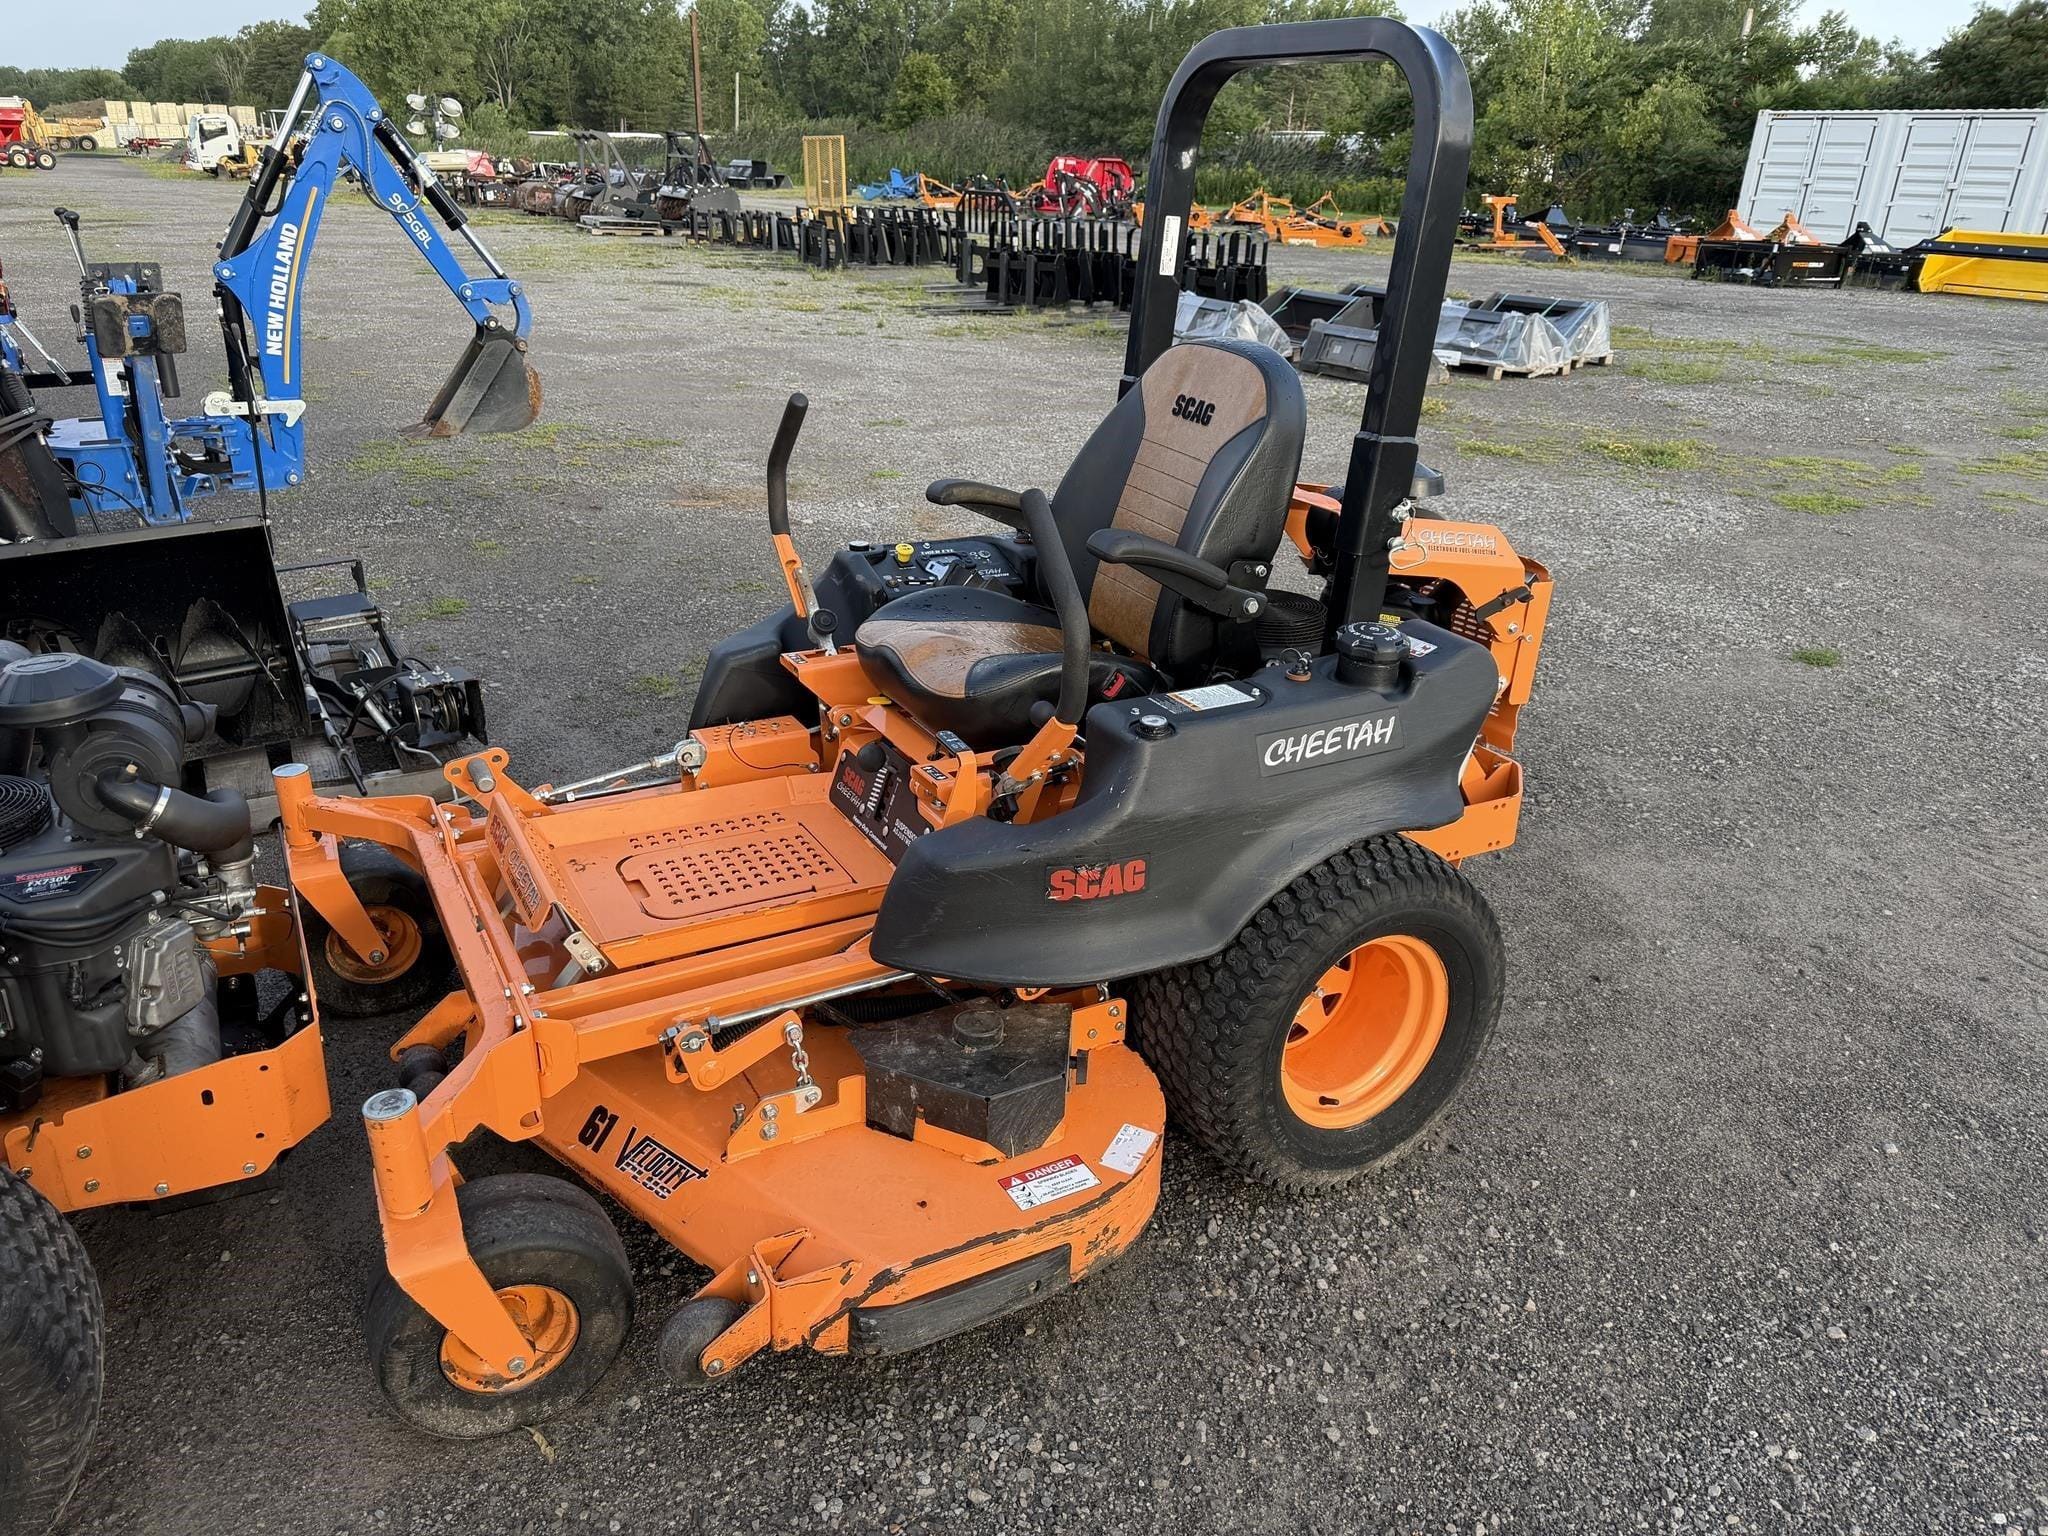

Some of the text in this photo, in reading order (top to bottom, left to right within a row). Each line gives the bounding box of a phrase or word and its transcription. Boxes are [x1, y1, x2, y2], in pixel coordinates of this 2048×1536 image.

[266, 222, 299, 356] NEW HOLLAND
[1171, 394, 1216, 426] SCAG
[1419, 529, 1496, 549] CHEETAH
[1264, 716, 1396, 766] CHEETAH
[836, 781, 862, 808] CHEETAH
[842, 766, 866, 796] SCAG
[15, 864, 83, 884] Kawasaki
[27, 874, 72, 887] FX730V
[1049, 859, 1146, 901] SCAG
[578, 1104, 619, 1154] 61
[619, 1160, 672, 1200] PLUS
[1026, 1158, 1075, 1181] DANGER
